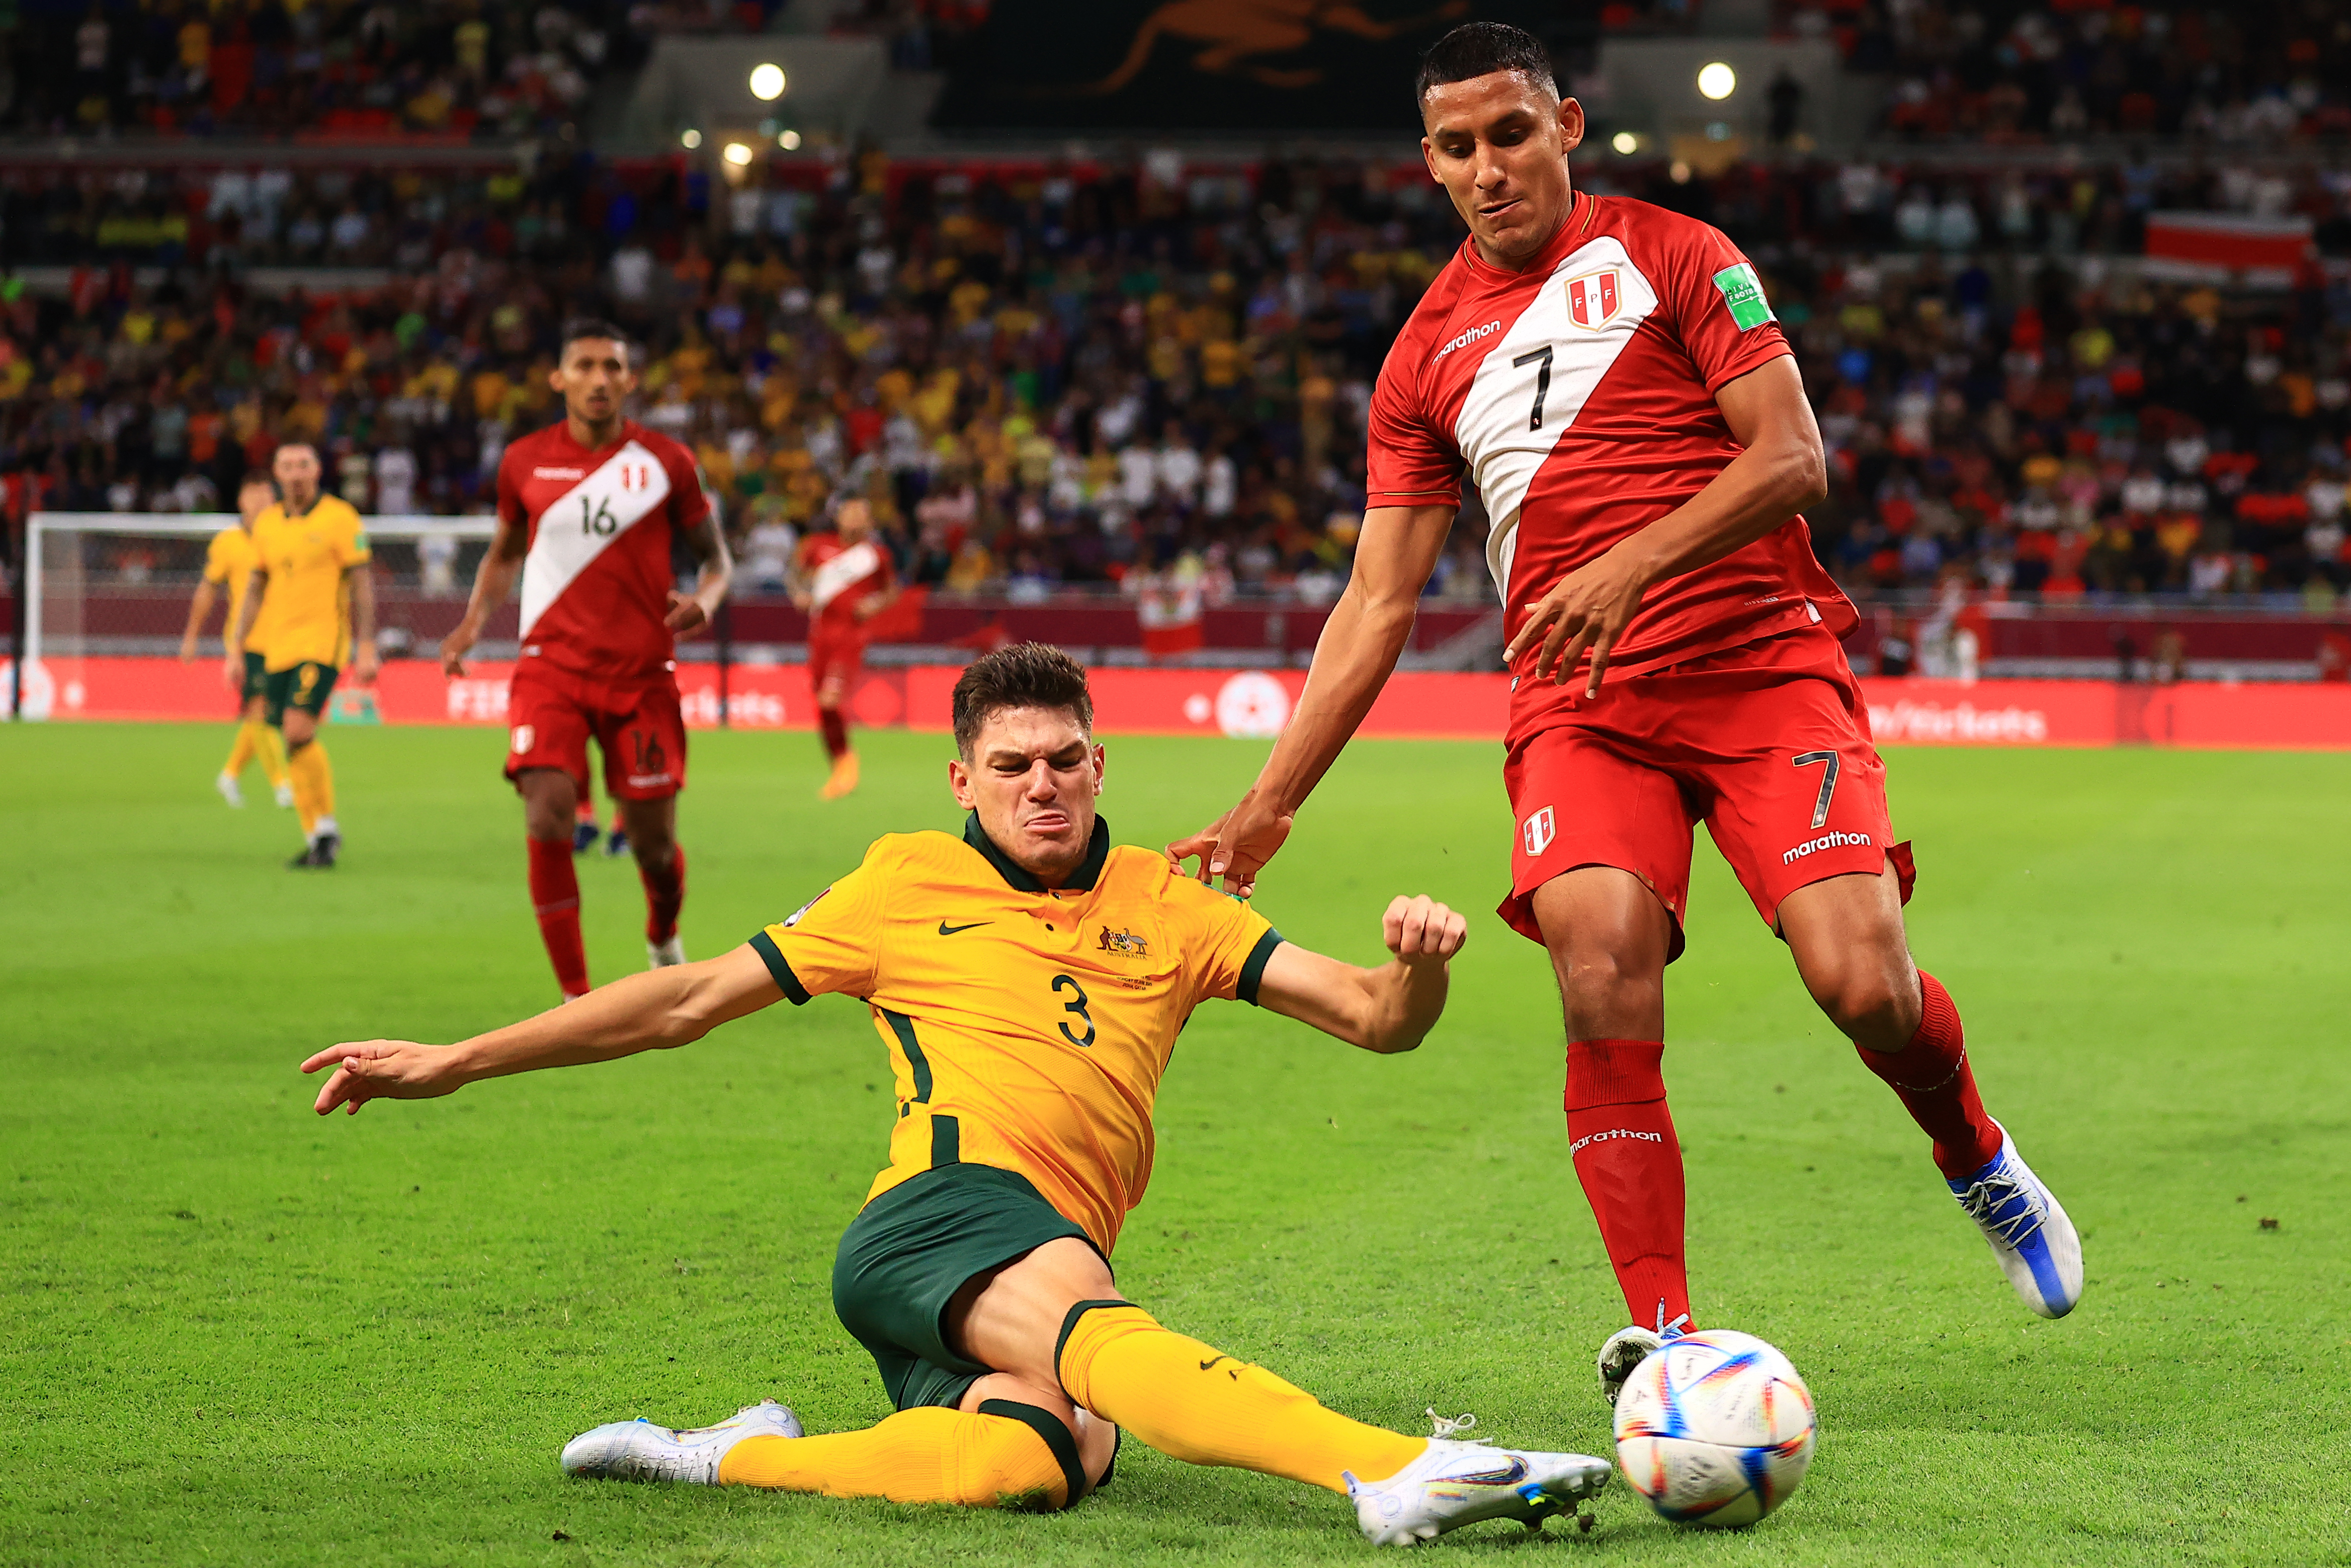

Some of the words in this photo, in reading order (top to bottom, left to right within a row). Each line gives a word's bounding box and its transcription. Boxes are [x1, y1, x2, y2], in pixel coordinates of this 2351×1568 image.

[1575, 288, 1612, 308] FPF
[1432, 320, 1500, 366] marathon
[1512, 344, 1553, 433] 7
[578, 494, 617, 536] 16
[630, 729, 665, 774] 16
[1792, 750, 1839, 829] 7
[1783, 831, 1871, 865] marathon
[1107, 950, 1147, 960] AUSTRALIA
[1051, 974, 1096, 1047] 3
[1569, 1129, 1662, 1157] marathon
